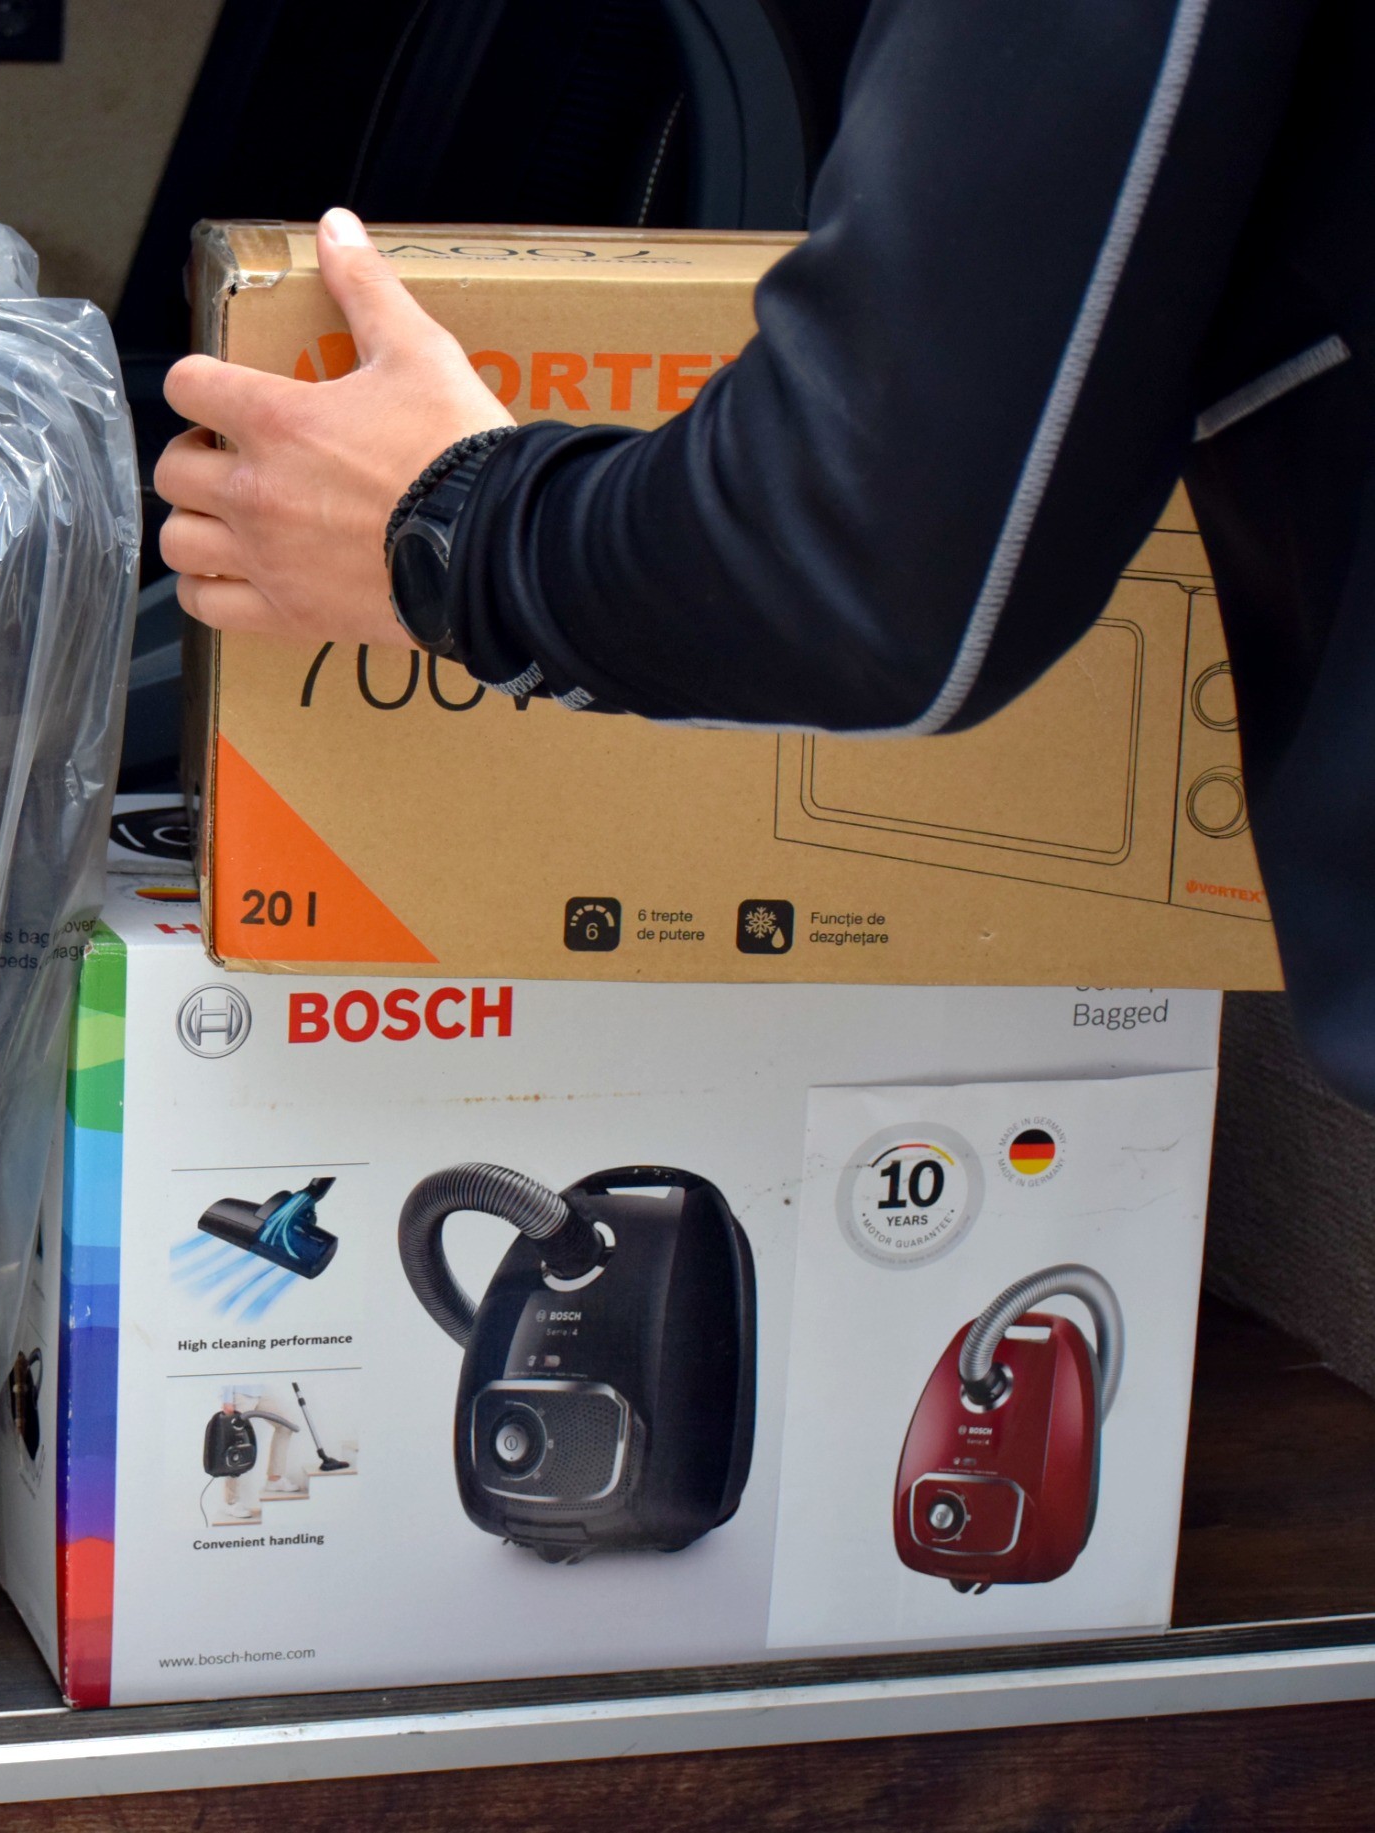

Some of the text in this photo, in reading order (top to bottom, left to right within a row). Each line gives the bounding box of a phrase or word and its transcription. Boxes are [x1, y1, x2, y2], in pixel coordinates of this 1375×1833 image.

[469, 350, 738, 412] ORTE
[300, 641, 531, 712] 700
[1198, 882, 1262, 904] VORTEX
[240, 889, 292, 927] 20
[638, 909, 693, 924] 6 trepte
[867, 912, 886, 925] de
[585, 922, 599, 940] 6
[637, 927, 705, 943] de putere
[288, 985, 513, 1044] BOSCH
[1073, 998, 1169, 1030] Bagged
[877, 1159, 945, 1209] 10
[886, 1214, 929, 1227] YEARS
[862, 1218, 893, 1247] MOTOR
[549, 1311, 582, 1321] BOSCH
[177, 1335, 353, 1352] High cleaning performance
[968, 1426, 993, 1435] BOSCH
[193, 1532, 325, 1550] Convenient handling
[158, 1648, 316, 1668] www.bosch-home.com
